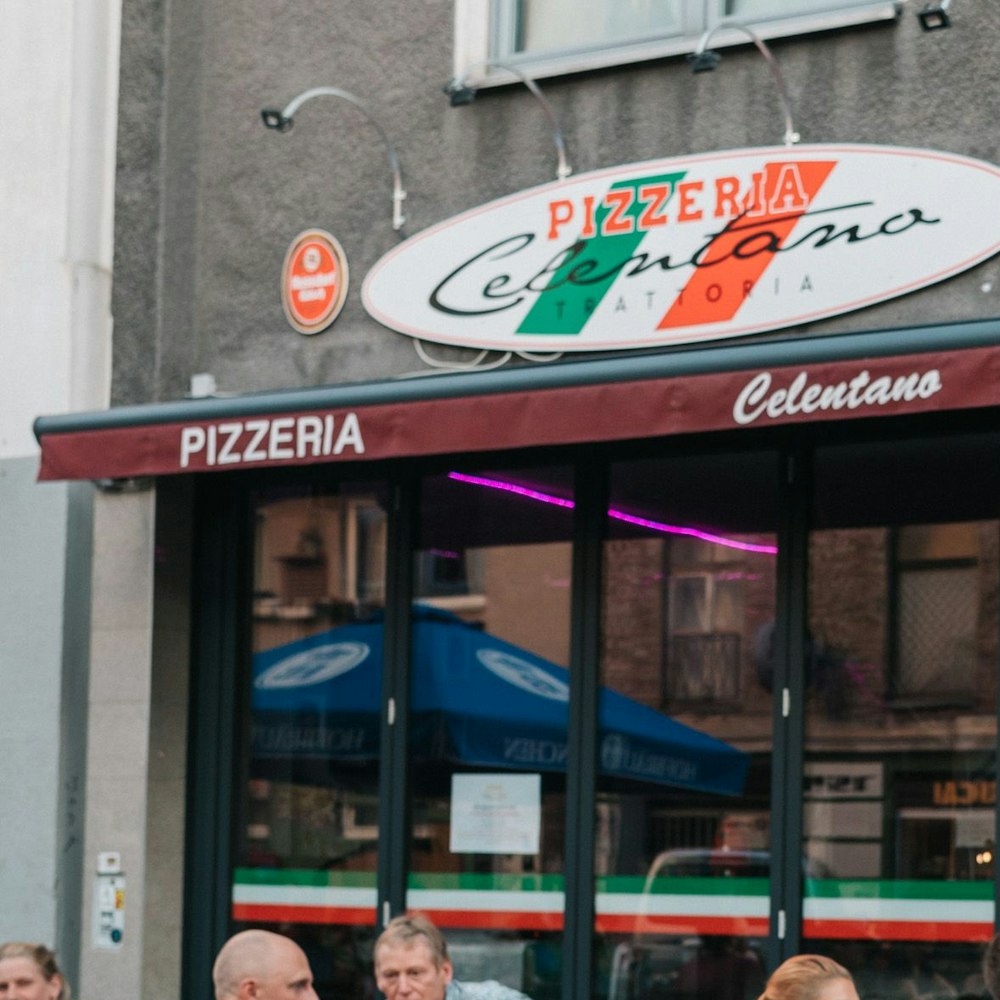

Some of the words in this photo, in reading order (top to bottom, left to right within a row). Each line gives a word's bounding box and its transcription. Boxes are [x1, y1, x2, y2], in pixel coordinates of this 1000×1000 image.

[547, 163, 812, 240] PIZZERIA
[428, 201, 941, 316] Celentano
[556, 274, 814, 319] TRATTORIA
[732, 368, 943, 426] Celentano
[180, 412, 366, 469] PIZZERIA
